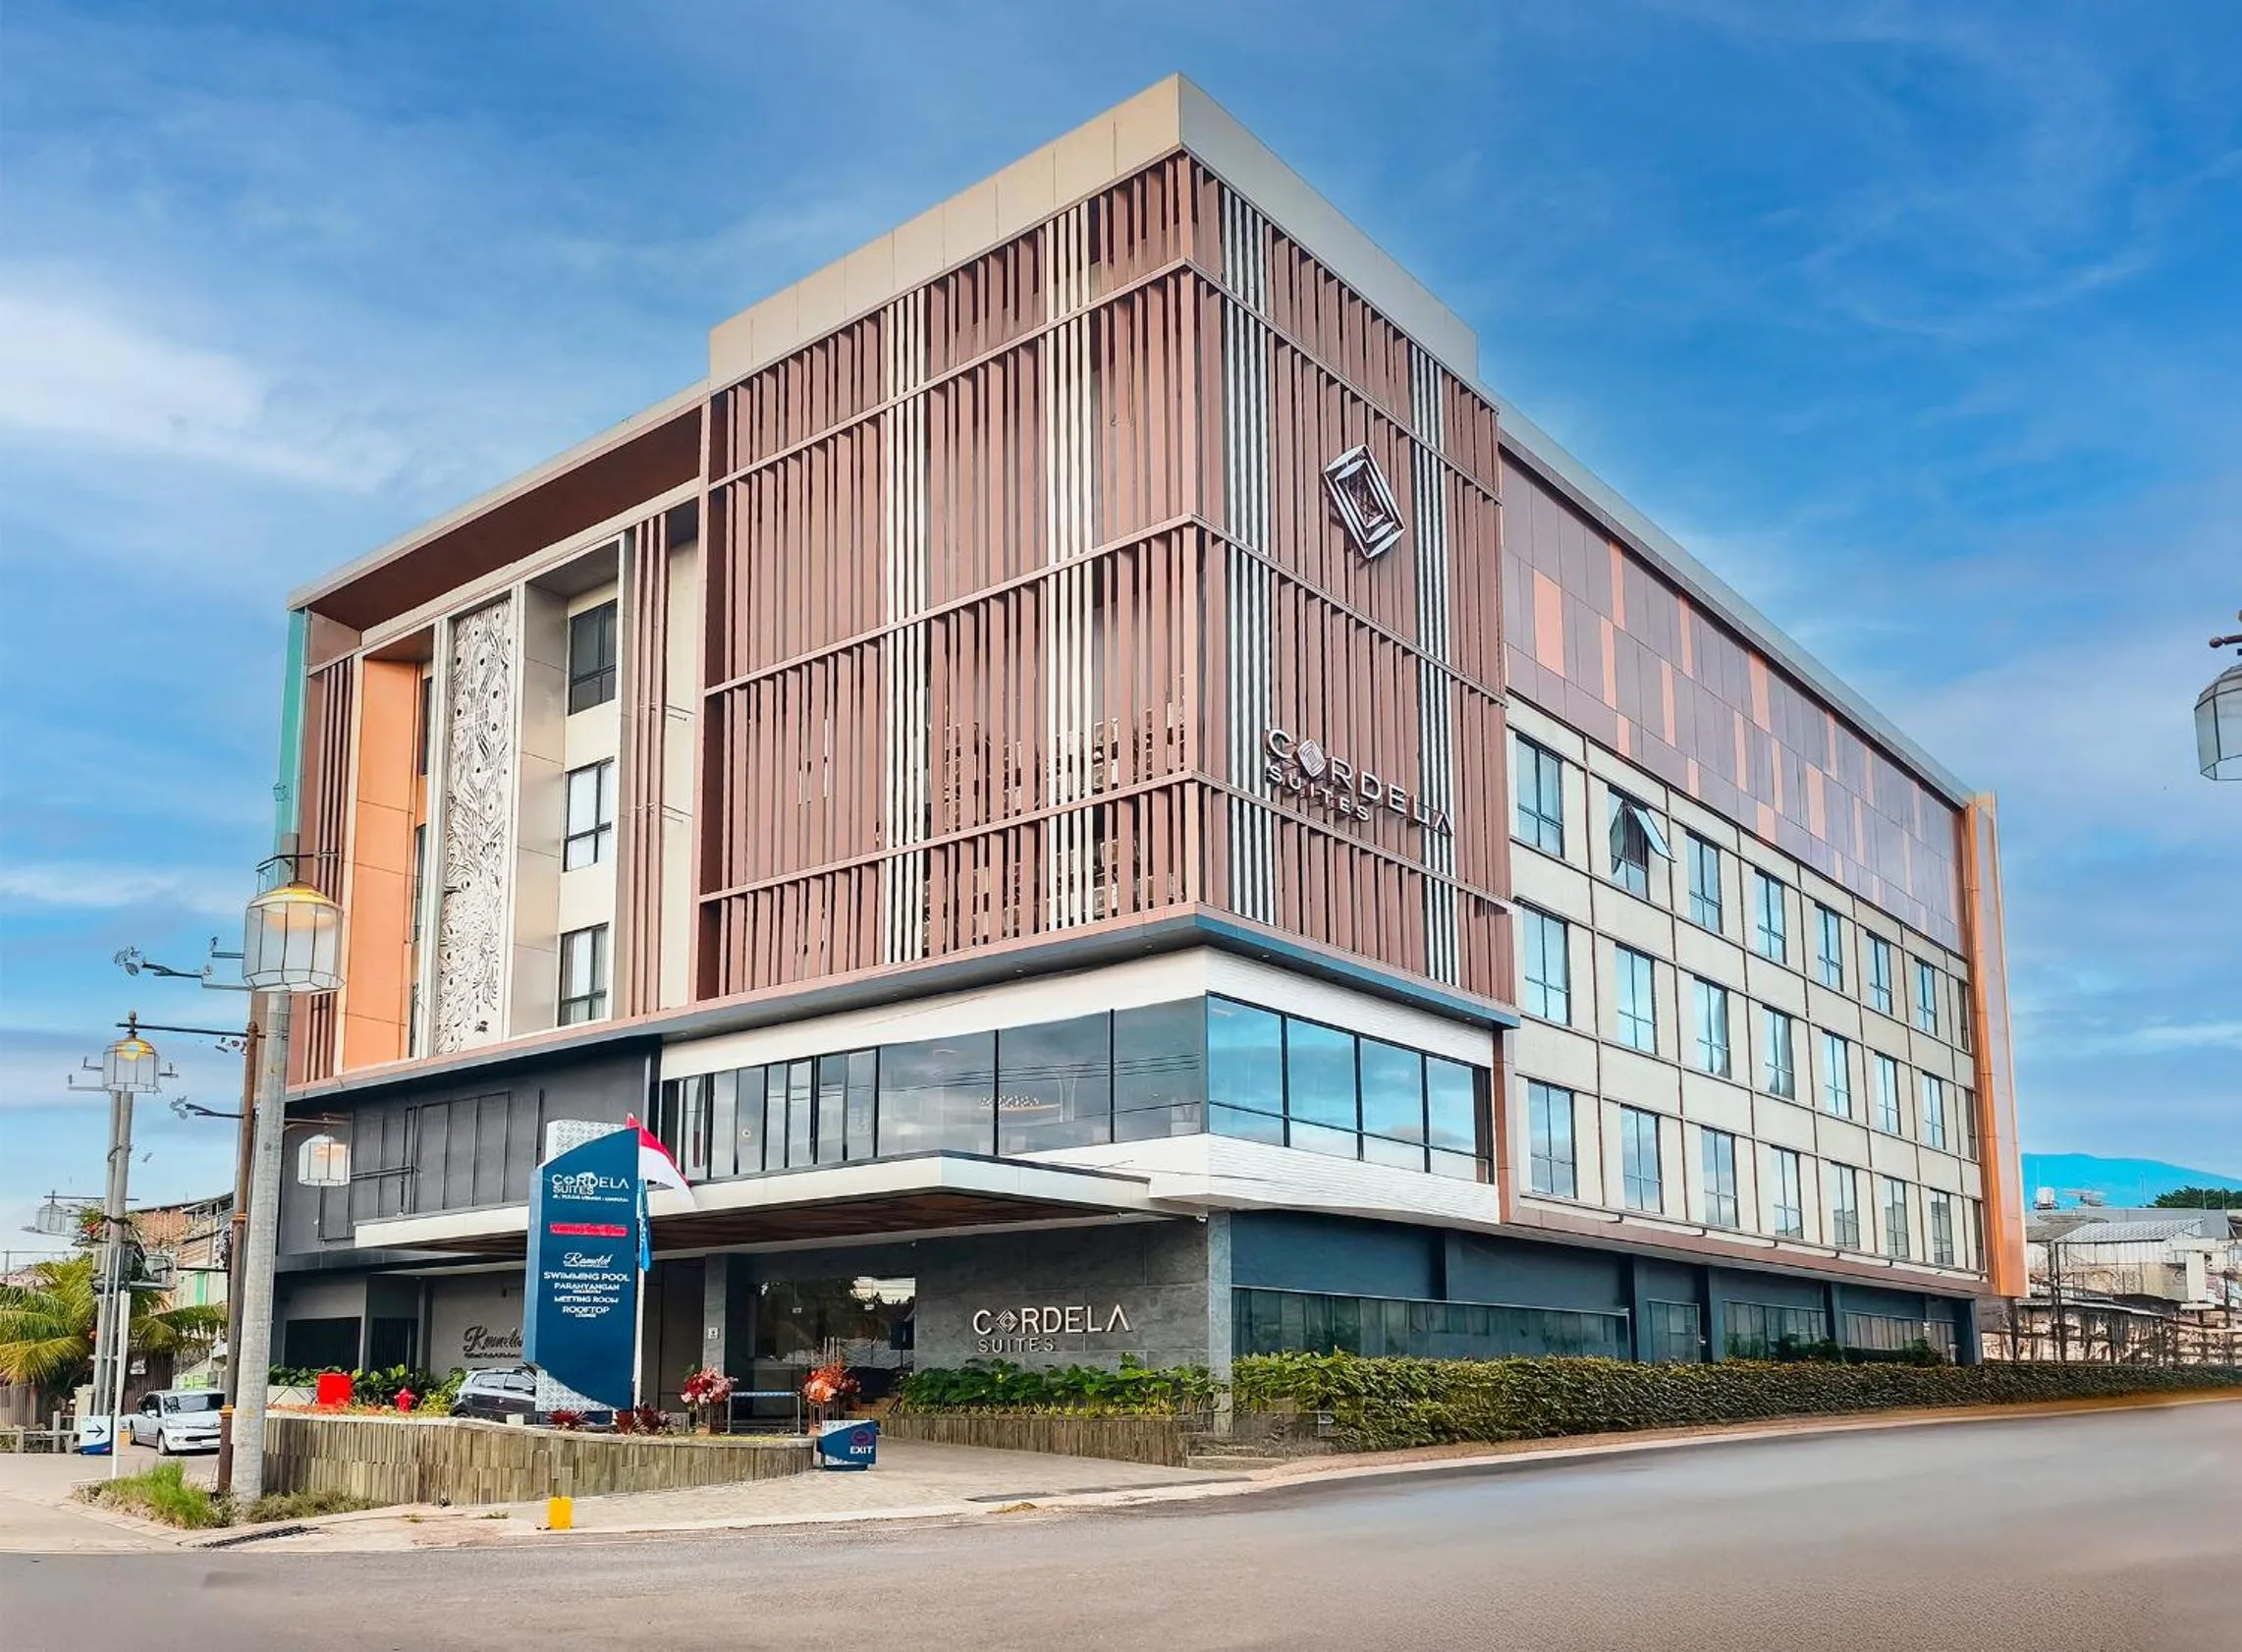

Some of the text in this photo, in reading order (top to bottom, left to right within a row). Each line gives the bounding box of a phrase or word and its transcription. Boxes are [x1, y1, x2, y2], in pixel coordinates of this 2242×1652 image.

[1267, 728, 1453, 836] CORDELA
[1266, 765, 1371, 821] SUITES
[552, 1172, 629, 1189] CORDELA
[552, 1184, 594, 1195] SUITES
[543, 1271, 631, 1283] SWIMMING POOL
[562, 1305, 610, 1314] ROOFTOP
[972, 1303, 1132, 1336] CORDELA
[977, 1337, 1056, 1353] SUITES
[849, 1445, 874, 1455] EXIT
